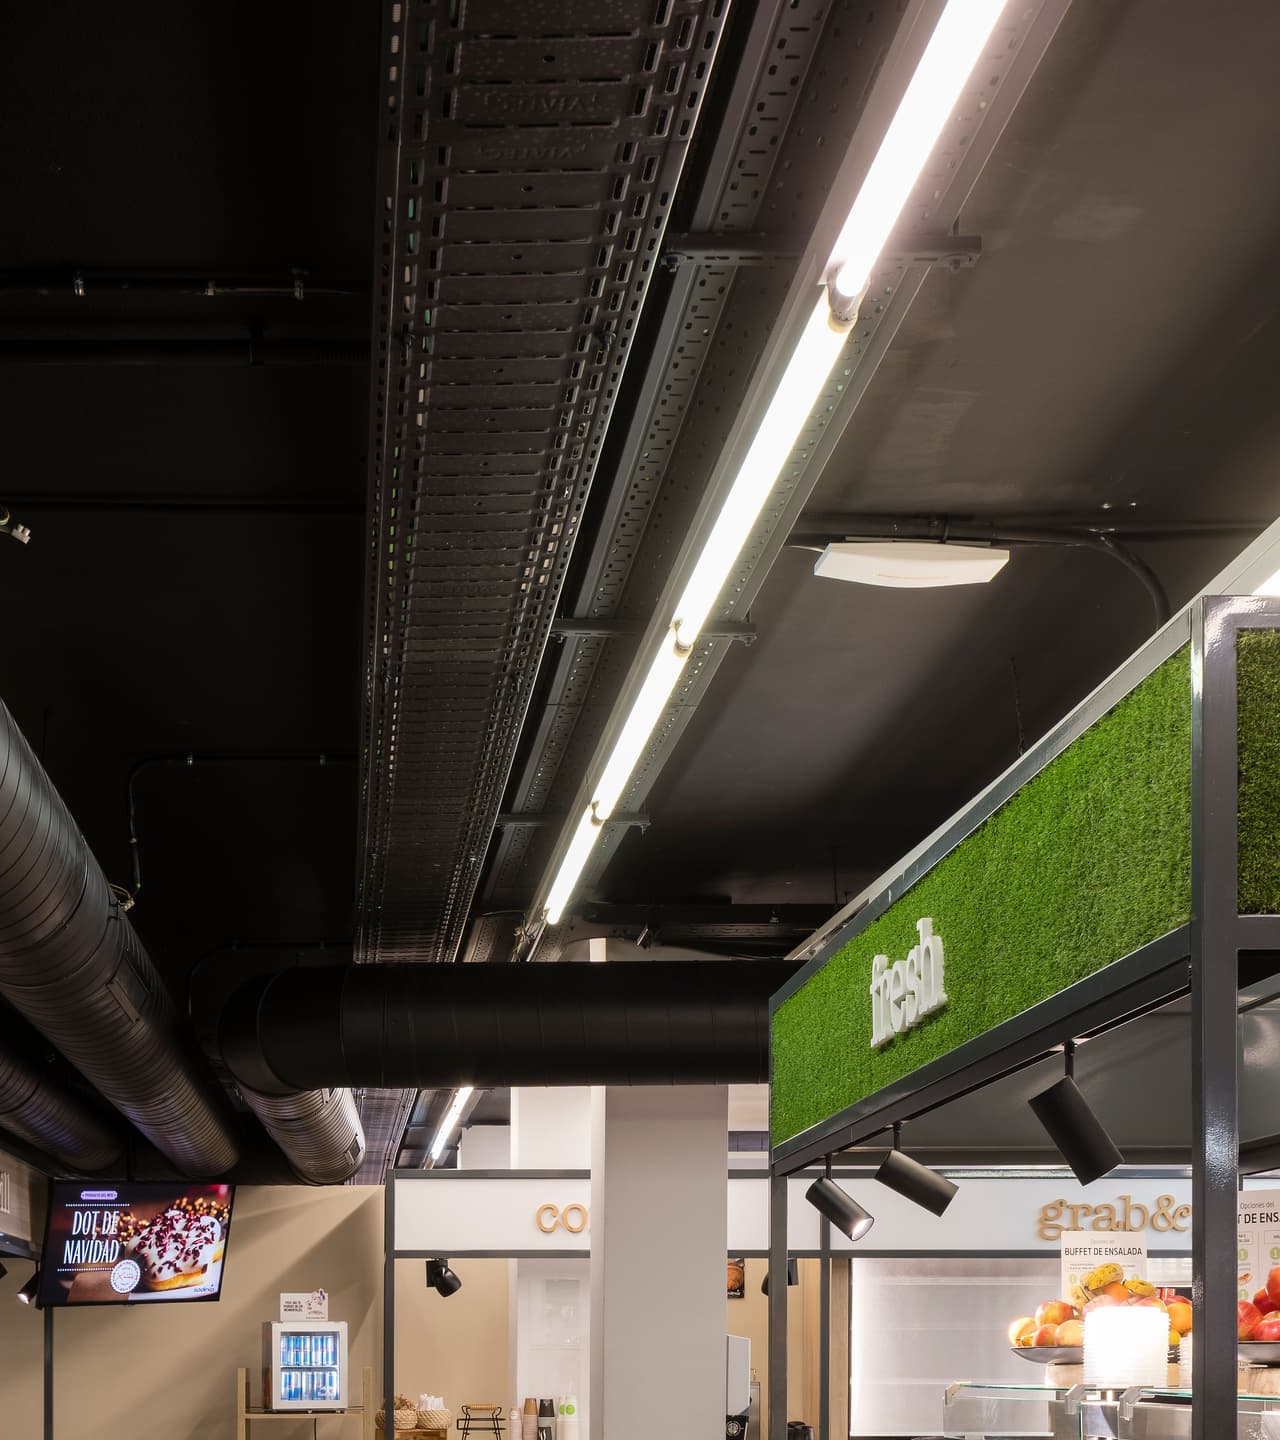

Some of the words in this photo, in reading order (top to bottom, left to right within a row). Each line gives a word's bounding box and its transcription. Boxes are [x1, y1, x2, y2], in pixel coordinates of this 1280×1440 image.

[870, 917, 948, 1048] fresh
[535, 1203, 590, 1233] co
[1240, 1202, 1265, 1210] Opciones
[72, 1210, 100, 1235] DOT
[102, 1210, 120, 1235] DE
[1244, 1213, 1257, 1224] DE
[63, 1240, 120, 1264] NAVIDAD
[1064, 1247, 1091, 1256] BUFFET
[1093, 1247, 1103, 1256] DE
[1104, 1247, 1143, 1256] ENSALADA
